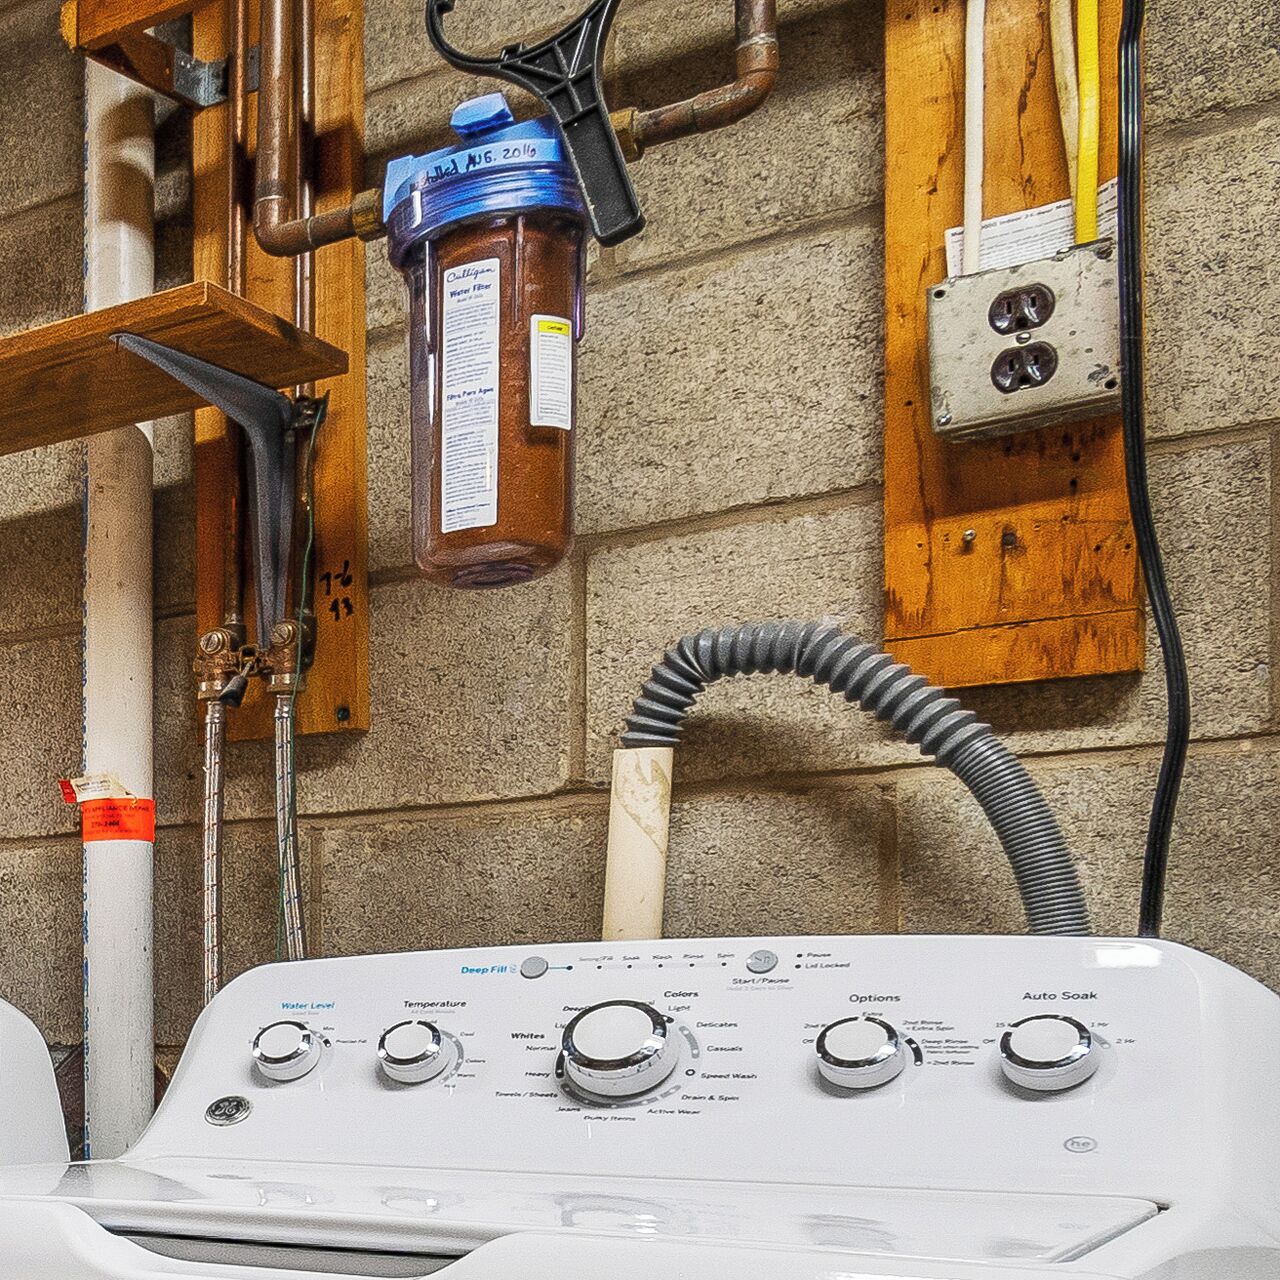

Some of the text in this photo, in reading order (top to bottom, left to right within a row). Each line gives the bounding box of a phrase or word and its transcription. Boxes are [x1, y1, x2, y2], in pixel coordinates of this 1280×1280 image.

[503, 143, 537, 159] 2016
[446, 267, 496, 283] Culligan
[461, 965, 508, 975] Deep Fill
[732, 977, 790, 985] Start/Pause
[664, 990, 699, 998] Colors
[849, 994, 901, 1003] Options
[1022, 991, 1099, 1000] Auto Soak
[403, 1000, 467, 1008] Temperature
